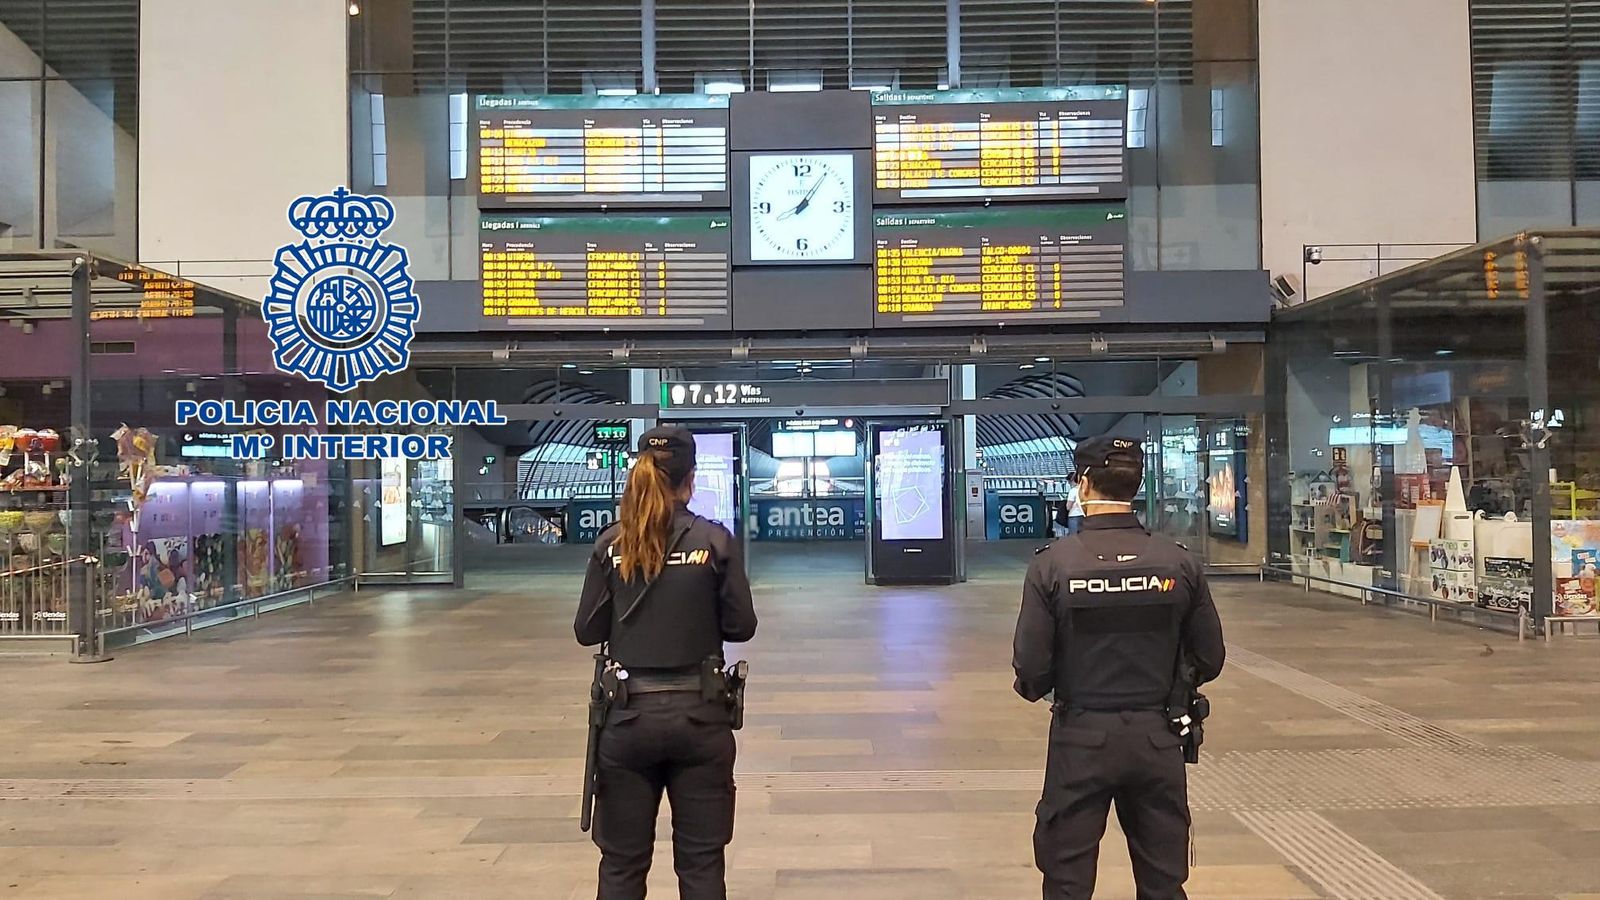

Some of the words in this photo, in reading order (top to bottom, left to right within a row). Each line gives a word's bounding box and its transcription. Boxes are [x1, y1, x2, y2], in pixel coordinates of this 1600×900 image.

[480, 99, 512, 107] Llegadas
[792, 164, 812, 177] 12
[759, 202, 771, 214] 9
[833, 201, 844, 213] 3
[482, 221, 514, 230] Llegadas
[876, 218, 903, 226] Salidas
[796, 238, 808, 251] 6
[902, 267, 929, 275] UTRERA
[982, 264, 1023, 273] CERCANIAS
[1053, 263, 1060, 272] 9
[982, 274, 1023, 282] CERCANIAS
[902, 285, 933, 294] PALACIO
[982, 283, 1023, 291] CERCANIAS
[982, 292, 1024, 300] CERCANIAS
[689, 384, 701, 404] 7
[714, 384, 737, 404] 12
[648, 438, 668, 446] CNP
[1113, 439, 1134, 448] CNP
[768, 503, 845, 526] antea
[1000, 505, 1033, 523] ea
[768, 528, 845, 537] PREVENCIÓN
[1069, 575, 1162, 593] POLICIA
